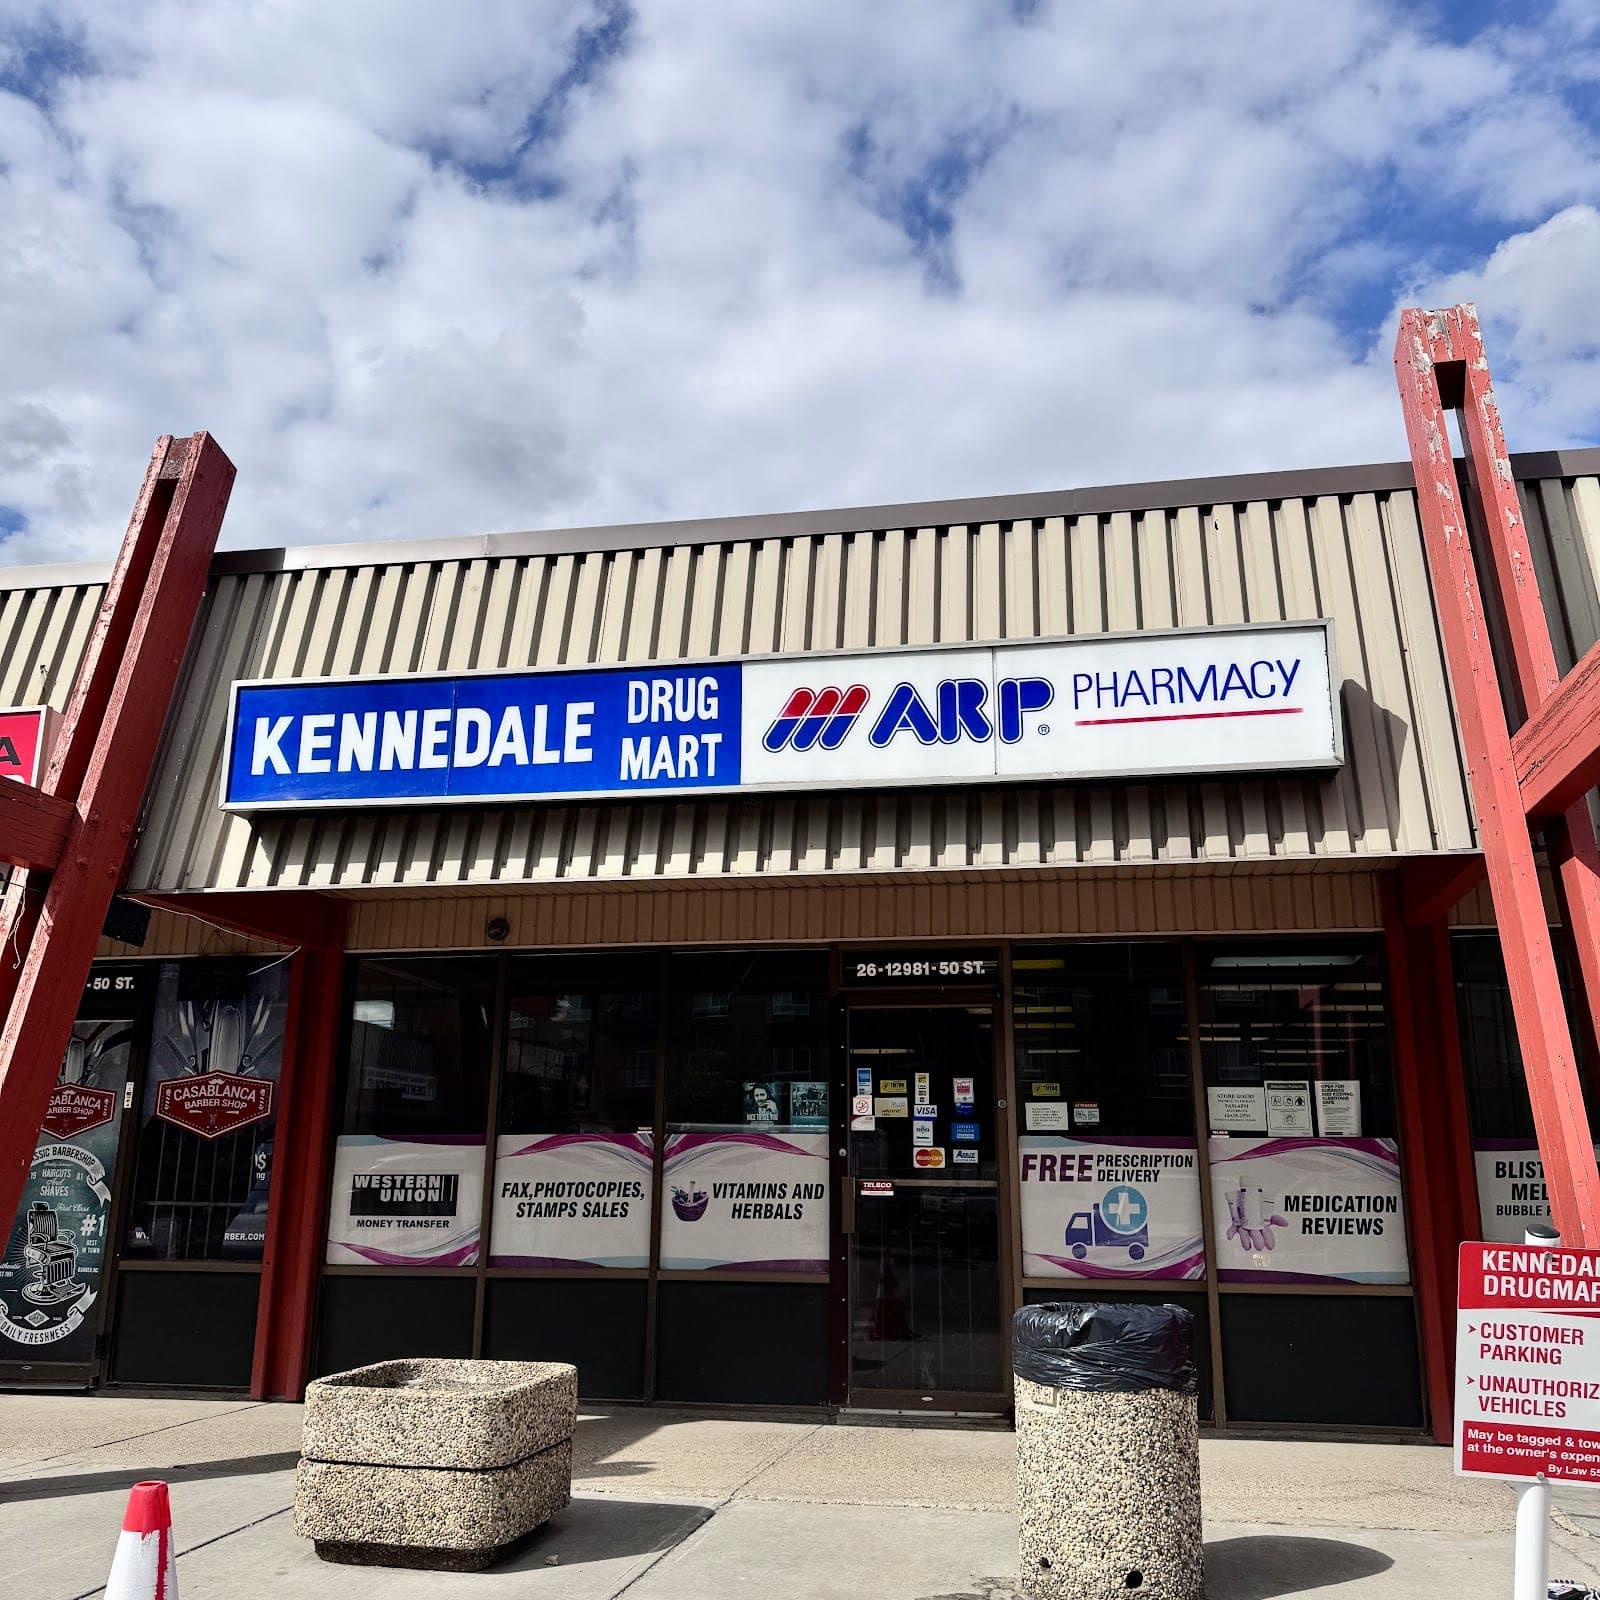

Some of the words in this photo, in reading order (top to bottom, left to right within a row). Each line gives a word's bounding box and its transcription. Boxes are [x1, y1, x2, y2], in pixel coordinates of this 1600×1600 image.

[1073, 659, 1301, 710] PHARMACY
[627, 676, 719, 724] DRUG
[869, 677, 1054, 748] ARP
[251, 702, 595, 776] KENNEDALE
[620, 733, 723, 781] MART
[962, 960, 985, 975] ST.
[114, 976, 135, 990] ST.
[173, 1084, 256, 1103] CASABLANCA
[72, 1106, 94, 1117] SHOP
[184, 1099, 221, 1110] BARBER
[221, 1099, 249, 1110] SHOP
[916, 1107, 937, 1116] VISA
[52, 1146, 96, 1168] BARBERSHOP
[1021, 1153, 1094, 1182] FREE
[1096, 1154, 1193, 1168] PRESCRIPTION
[1097, 1169, 1160, 1182] DELIVERY
[40, 1185, 70, 1197] SHAVES
[354, 1175, 441, 1189] WESTERN
[501, 1181, 645, 1201] FAX,PHOTOCOPIES,
[712, 1182, 788, 1199] VITAMINS
[791, 1182, 825, 1200] AND
[380, 1188, 440, 1203] UNION
[1284, 1195, 1398, 1213] MEDICATION
[516, 1201, 578, 1218] STAMPS
[581, 1201, 630, 1218] SALES
[731, 1203, 804, 1220] HERBALS
[1496, 1204, 1543, 1216] BUBBLE
[80, 1213, 106, 1238] #1
[356, 1219, 393, 1228] MONEY
[396, 1219, 451, 1228] TRANSFER
[1301, 1217, 1384, 1236] REVIEWS
[23, 1322, 72, 1344] FRESHNESS
[1480, 1321, 1584, 1346] CUSTOMER
[1480, 1343, 1562, 1365] PARKING
[1478, 1395, 1567, 1418] VEHICLES
[1467, 1428, 1495, 1443] May
[1497, 1430, 1514, 1442] be
[1517, 1434, 1561, 1448] tagged
[1564, 1437, 1578, 1448] &
[1467, 1443, 1480, 1453] at
[1482, 1443, 1504, 1455] the
[1506, 1447, 1557, 1460] owner's
[1548, 1464, 1562, 1476] By
[1565, 1465, 1588, 1477] Law
